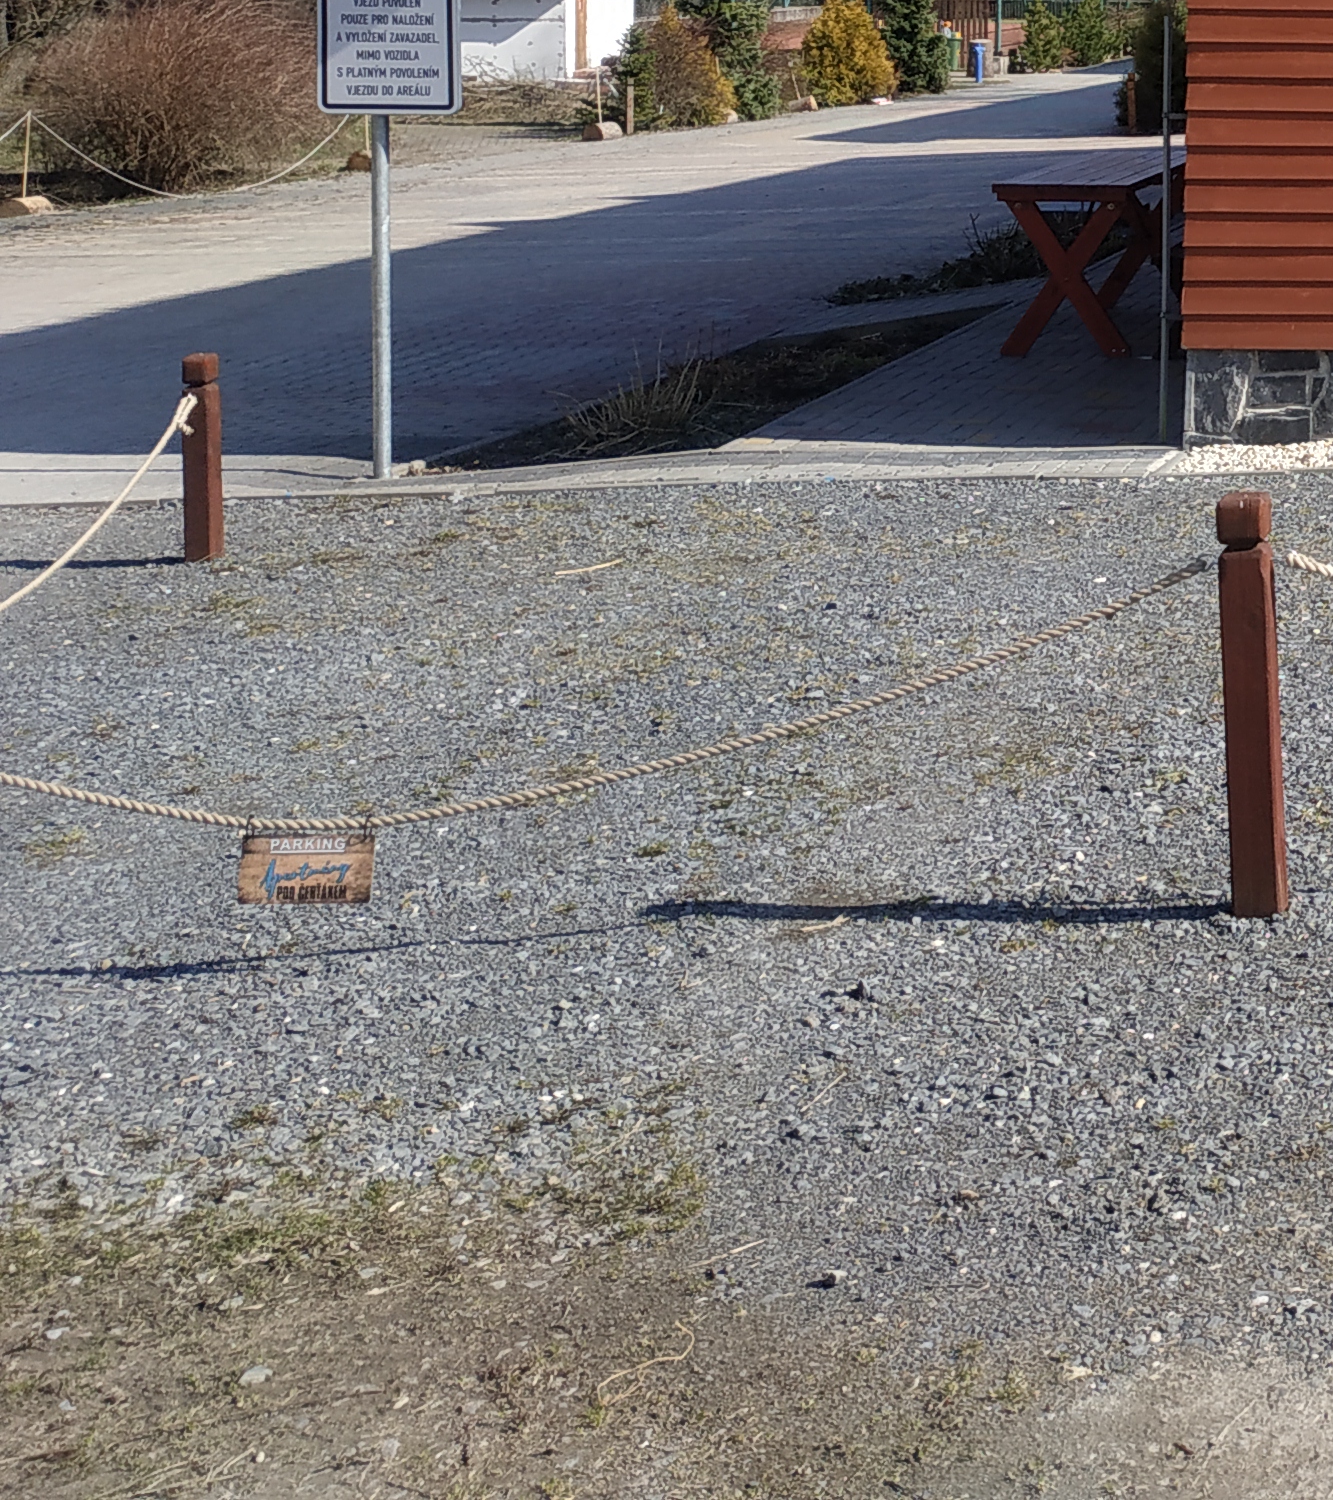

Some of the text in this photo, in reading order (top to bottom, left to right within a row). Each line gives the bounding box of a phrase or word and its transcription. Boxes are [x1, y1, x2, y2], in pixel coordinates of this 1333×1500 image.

[341, 12, 435, 26] POUZE PRO NALOŽENÍ
[336, 32, 342, 42] A
[345, 29, 387, 43] VYLOŽENÍ
[356, 49, 419, 61] MIMO VOZIDLA
[336, 65, 439, 78] S PLATNÝM POVOLENÍM
[346, 82, 431, 97] VJEZDU DO AREÁLU
[270, 837, 346, 851] PARKING
[276, 885, 295, 900] POD
